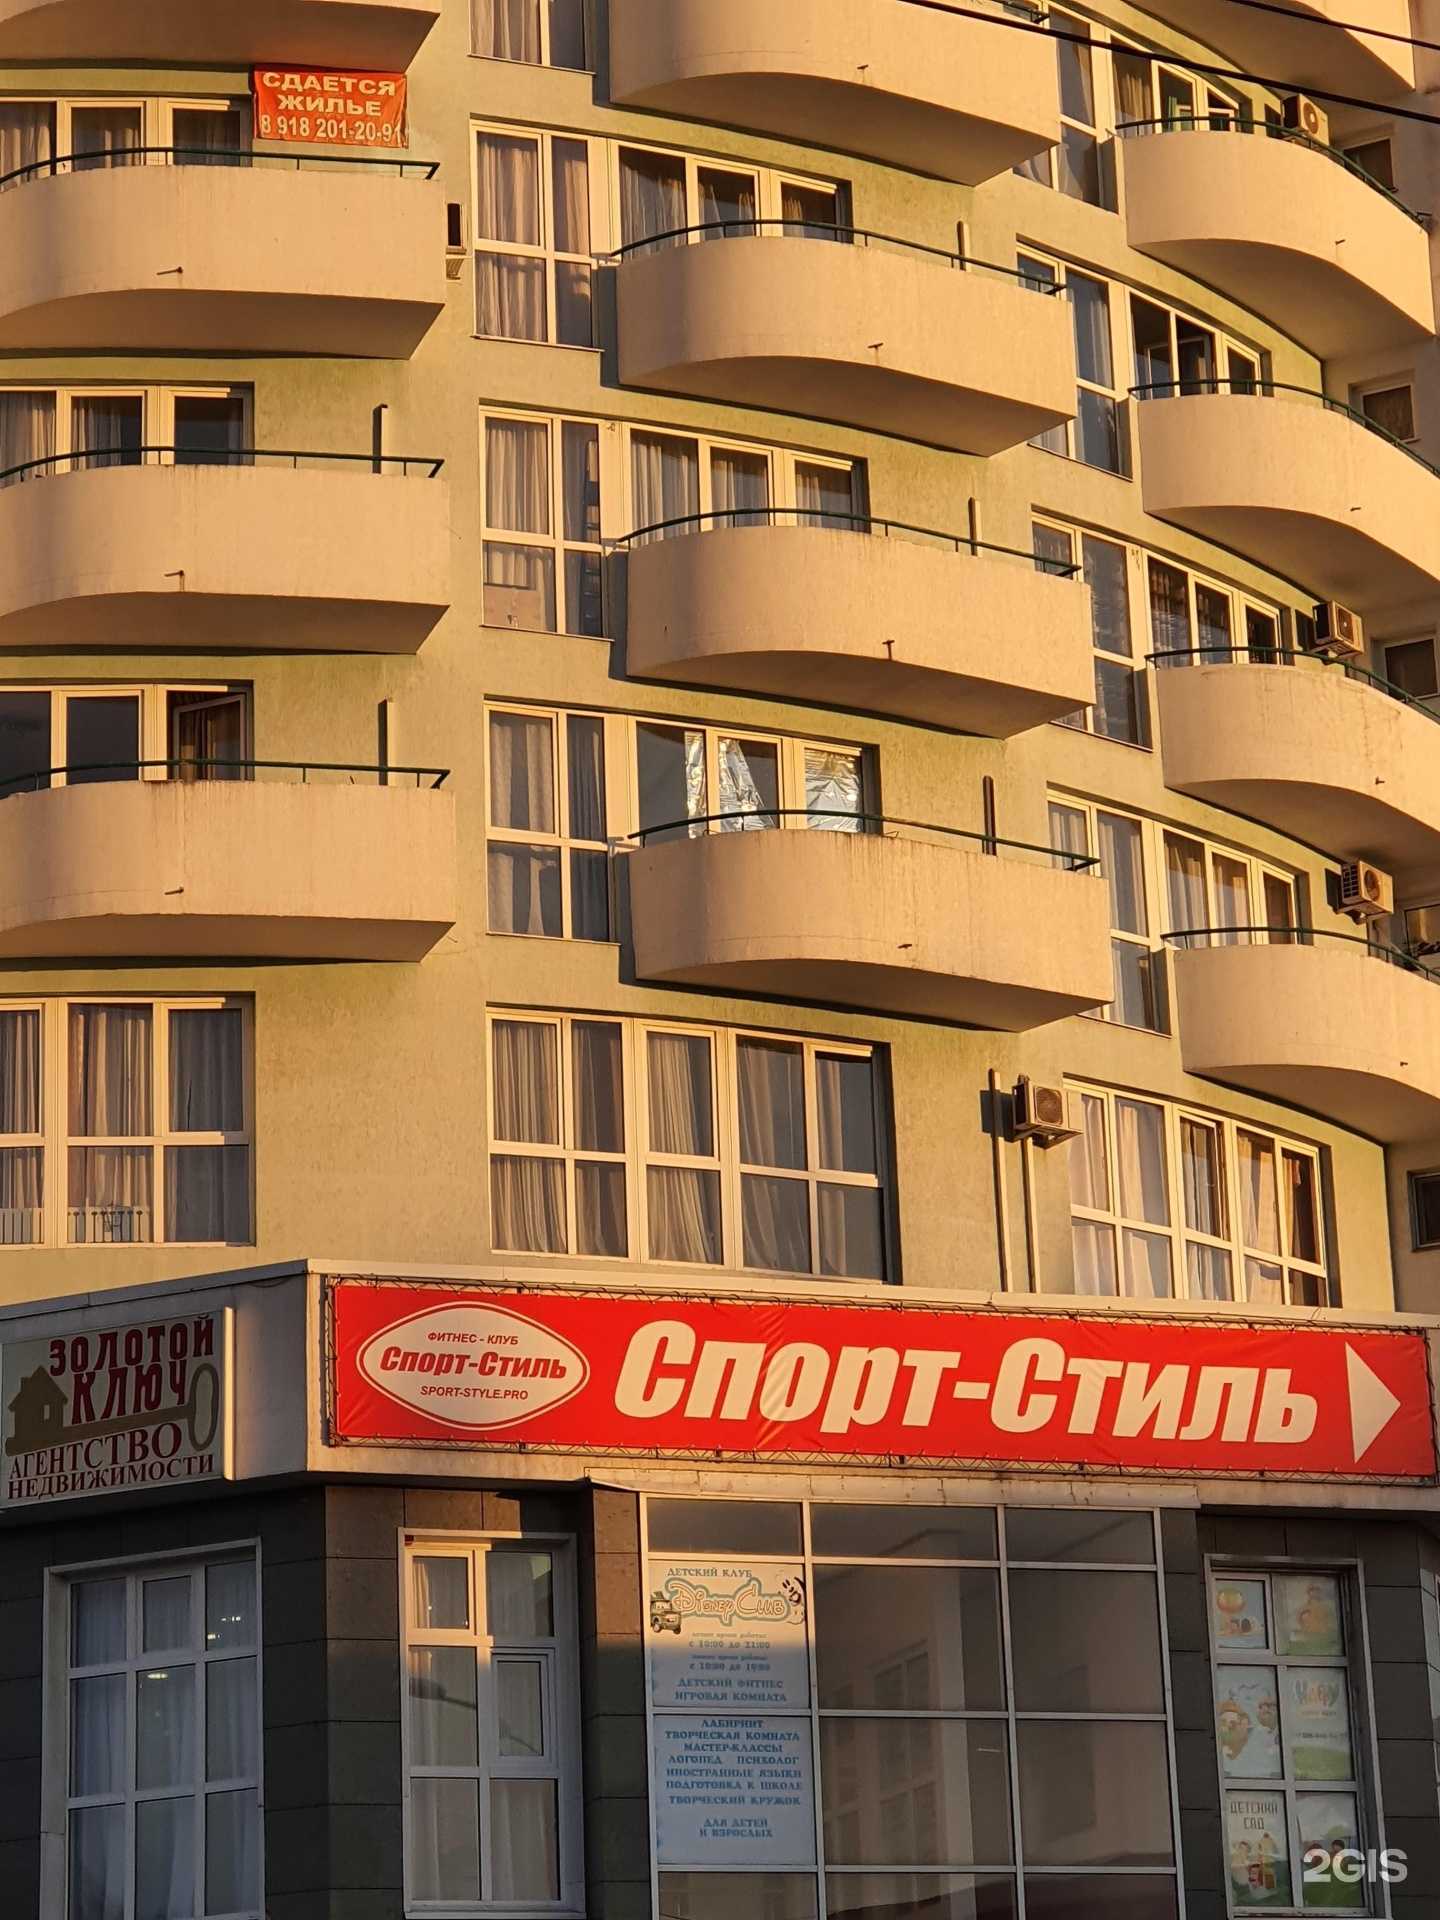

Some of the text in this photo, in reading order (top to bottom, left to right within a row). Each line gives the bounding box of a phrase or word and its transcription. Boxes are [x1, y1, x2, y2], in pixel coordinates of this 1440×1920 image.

[263, 72, 396, 96] СДАЕТСЯ
[277, 94, 382, 116] ЖИЛЬЕ
[261, 114, 271, 134] 8
[277, 115, 310, 137] 918
[50, 1313, 213, 1377] ЗОЛОТОЙ
[428, 1332, 477, 1344] ФИТНЕС
[487, 1335, 518, 1346] КЛУБ
[380, 1346, 567, 1379] Спорт-Стиль
[614, 1319, 1318, 1443] Спорт-Стиль
[72, 1360, 187, 1425] КЛЮЧ
[420, 1386, 529, 1400] SPORT-STYLE.PRO
[10, 1422, 182, 1479] АГЕНТСТВО
[8, 1454, 213, 1500] НЕДВИЖИМОСТИ
[666, 1567, 752, 1578] ДЕТСКИЙ КЛУБ
[678, 1678, 783, 1688] ДЕТСКИЙ ФИТНЕС
[675, 1691, 786, 1702] ИГРОВАЯ КОМНАТА
[702, 1719, 764, 1728] ЛАБИРИНТ
[665, 1731, 800, 1741] ТВОРЧЕСКАЯ КОМНАТА
[684, 1743, 783, 1753] МАСТЕР-КЛАССЫ
[668, 1755, 800, 1765] ЛОГОПЕД ПСИХОЛОГ
[667, 1768, 801, 1778] ИНОСТРАННЫЕ ЯЗЫКИ
[666, 1781, 742, 1790] ПОДГОТОВКА
[761, 1782, 801, 1790] ШКОЛЕ
[669, 1795, 801, 1805] ТВОРЧЕСКИЙ КРУЖОК
[1230, 1800, 1278, 1815] ДЕТСКИЙ
[704, 1818, 768, 1827] ДЛЯ ДЕТЕЙ
[1244, 1816, 1265, 1830] САД
[712, 1829, 773, 1838] ВЗРОСЛЫХ
